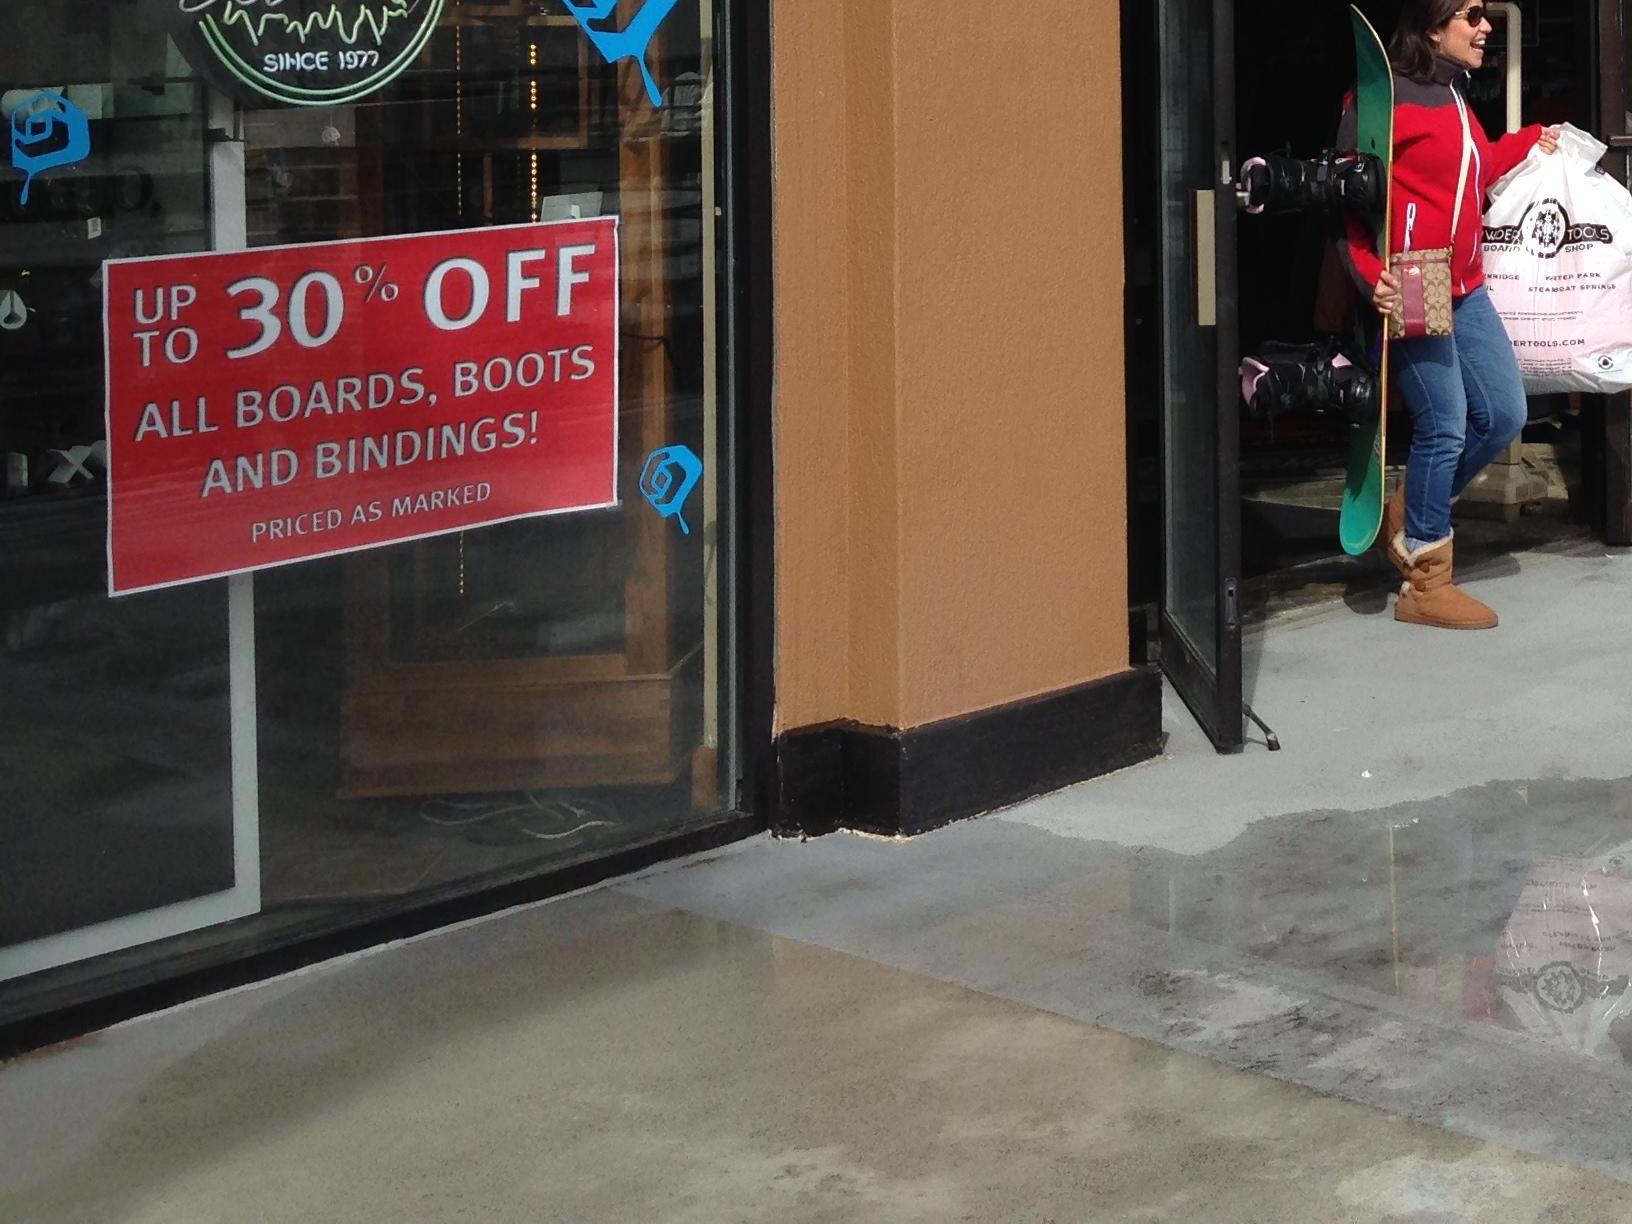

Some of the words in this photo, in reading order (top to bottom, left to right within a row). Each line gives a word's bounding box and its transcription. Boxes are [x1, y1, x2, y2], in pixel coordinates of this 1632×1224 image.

[263, 51, 329, 72] SINCE
[338, 50, 379, 70] 1977
[1484, 228, 1522, 244] WDER
[1568, 226, 1611, 241] TOOLS
[1565, 243, 1594, 253] SHOP
[424, 244, 597, 331] OFF
[1577, 272, 1601, 280] PARK
[134, 284, 197, 324] UP
[133, 327, 199, 367] TO
[1509, 339, 1585, 347] ERTOOLS.COM
[135, 397, 219, 442] ALL
[236, 367, 438, 430] BOARDS,
[454, 344, 596, 400] BOOTS
[201, 447, 298, 498] AND
[316, 411, 539, 479] BINDINGS!
[251, 508, 342, 543] PRICED
[350, 502, 383, 528] AS
[392, 482, 491, 518] MARKED
